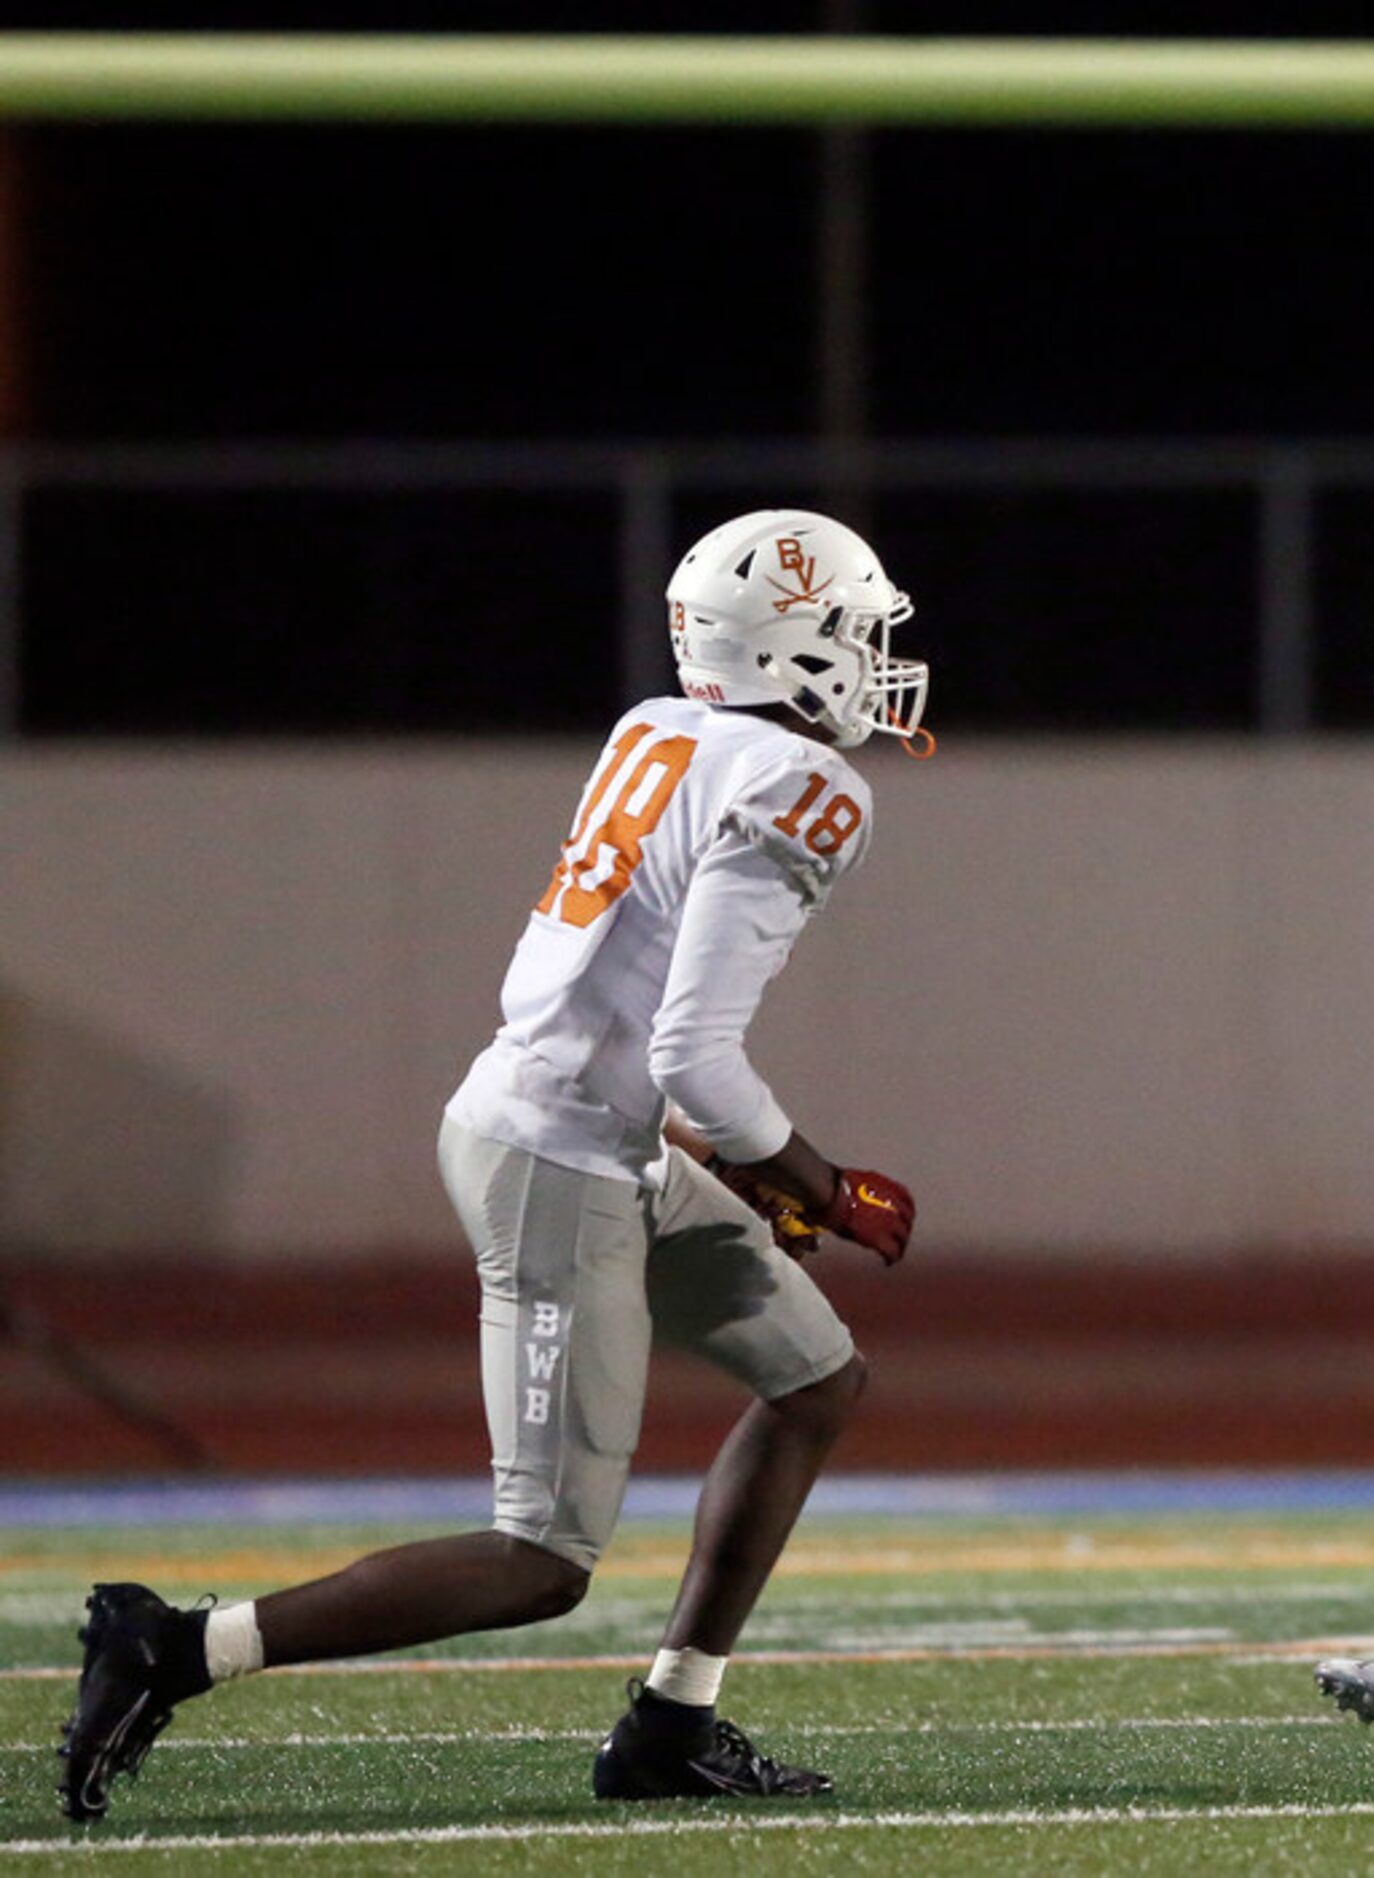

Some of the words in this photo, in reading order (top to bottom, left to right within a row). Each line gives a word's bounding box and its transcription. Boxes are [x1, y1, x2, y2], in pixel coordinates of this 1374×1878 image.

[776, 538, 815, 592] BV
[535, 722, 698, 929] 18
[772, 771, 862, 856] 18
